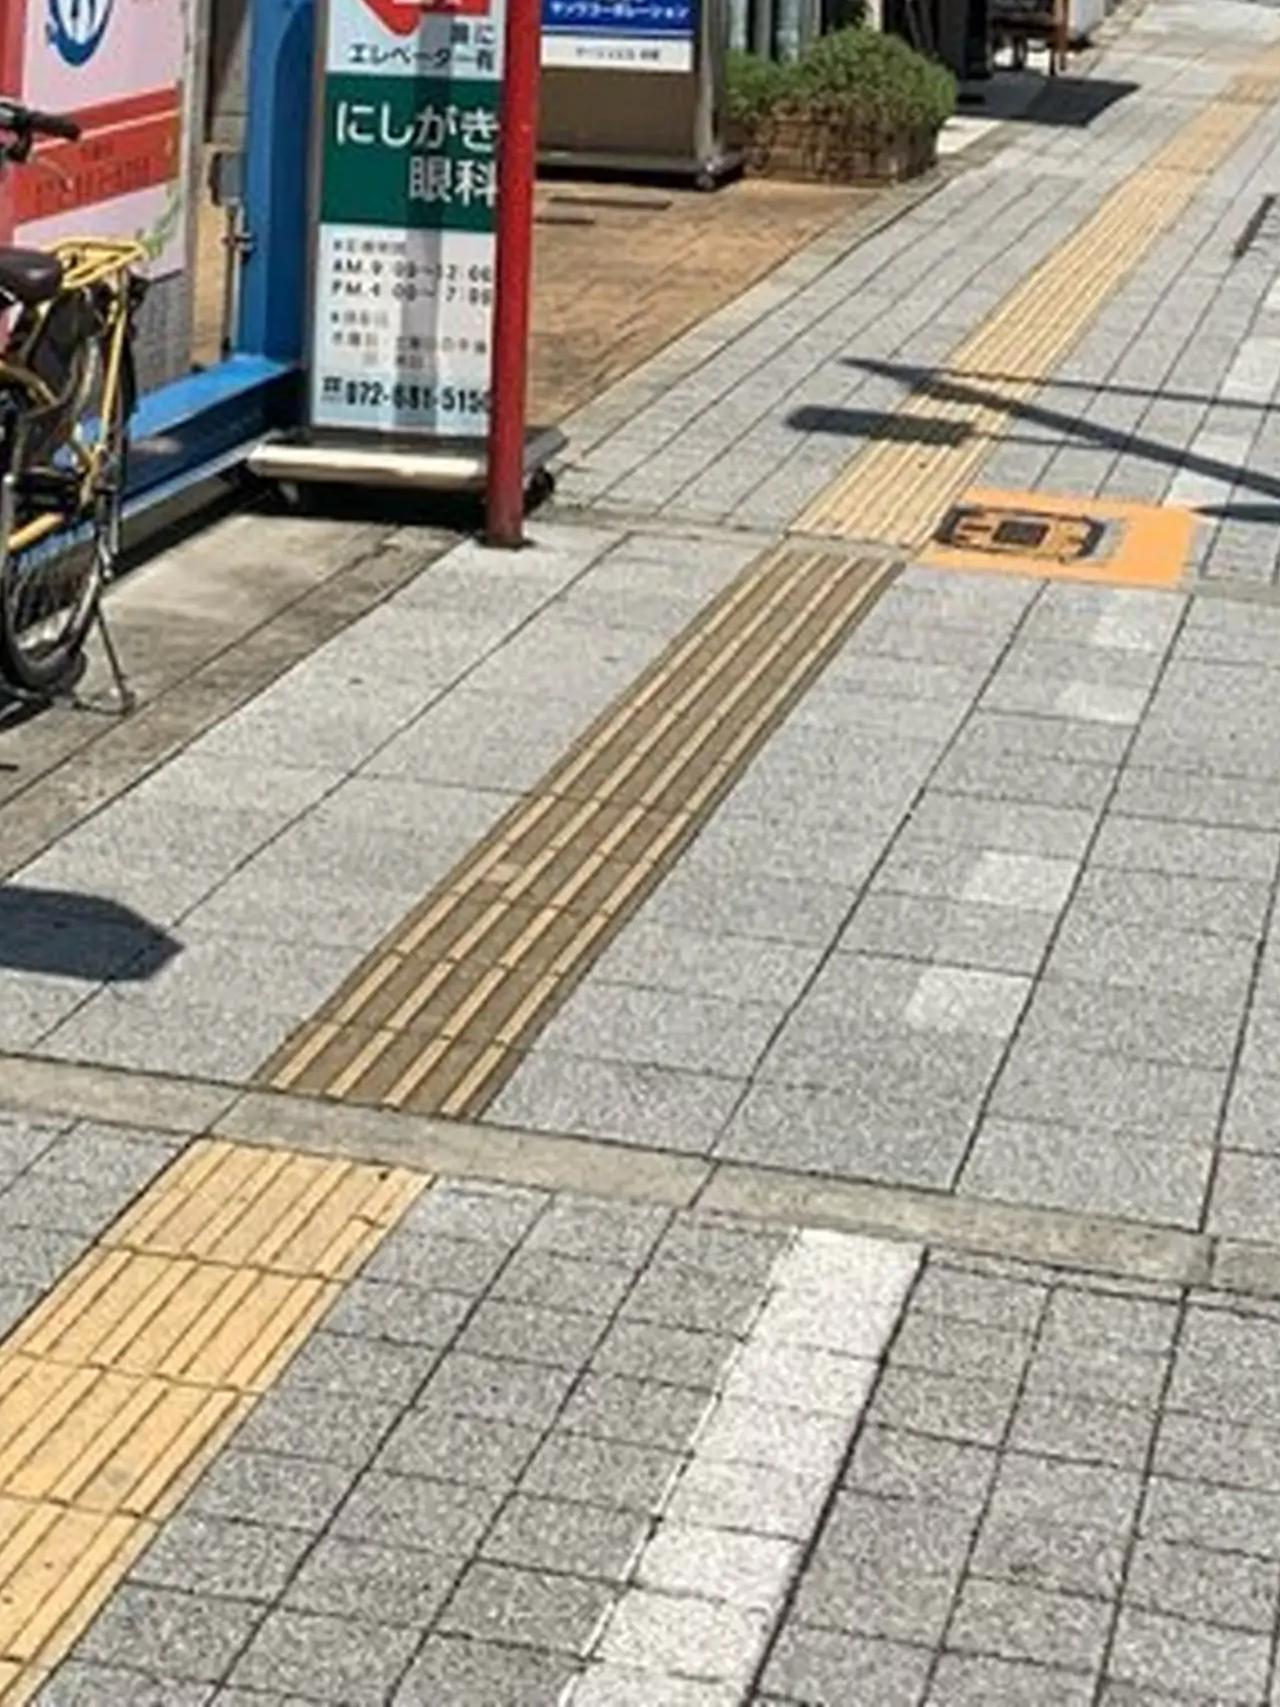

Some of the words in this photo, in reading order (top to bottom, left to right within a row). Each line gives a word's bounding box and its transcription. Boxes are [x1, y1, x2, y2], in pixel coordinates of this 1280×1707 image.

[336, 100, 501, 153] にしがき
[408, 155, 500, 208] 眼科
